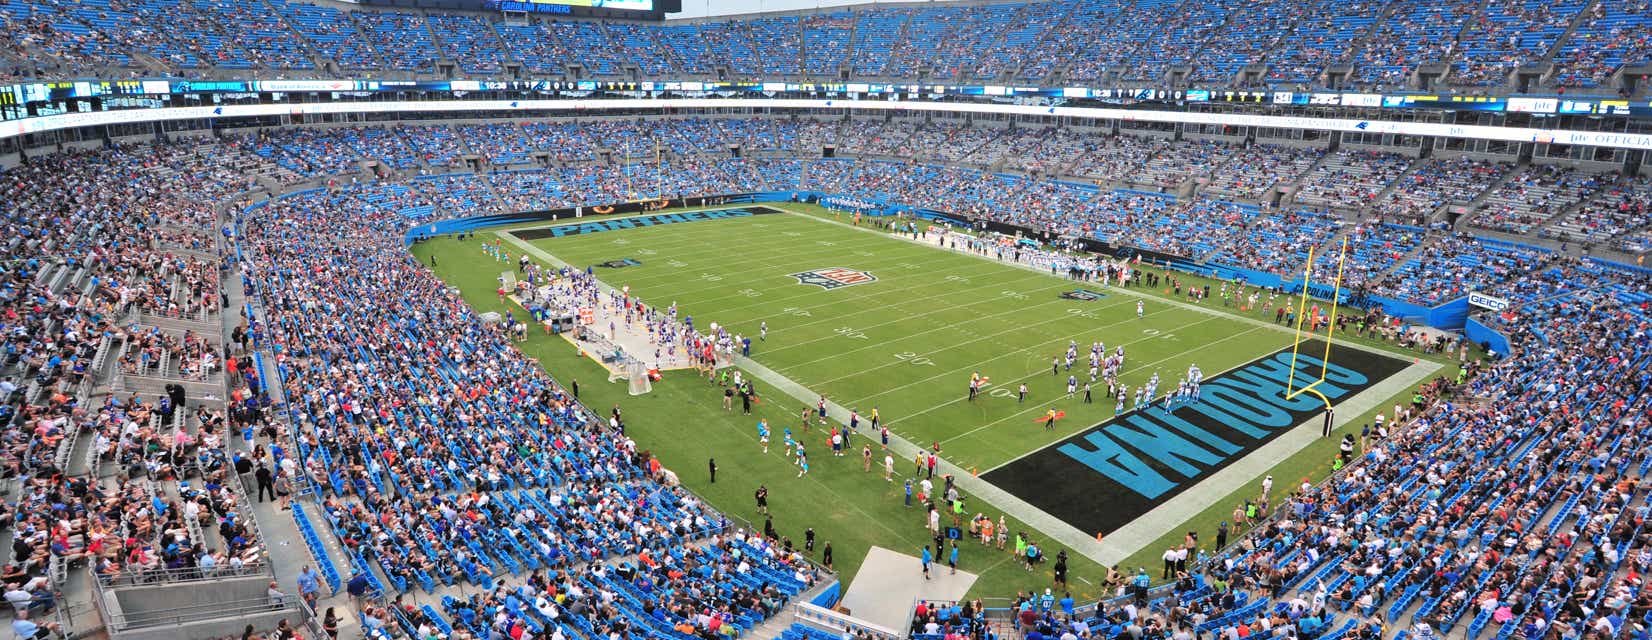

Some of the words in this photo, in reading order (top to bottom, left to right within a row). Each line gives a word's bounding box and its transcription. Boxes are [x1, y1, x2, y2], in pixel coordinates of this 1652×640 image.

[501, 2, 535, 12] CAROLINA
[537, 4, 571, 13] PANTHERS
[551, 209, 753, 237] PANTHERS
[1471, 295, 1505, 310] GEICO
[1057, 353, 1369, 500] CAROLINA
